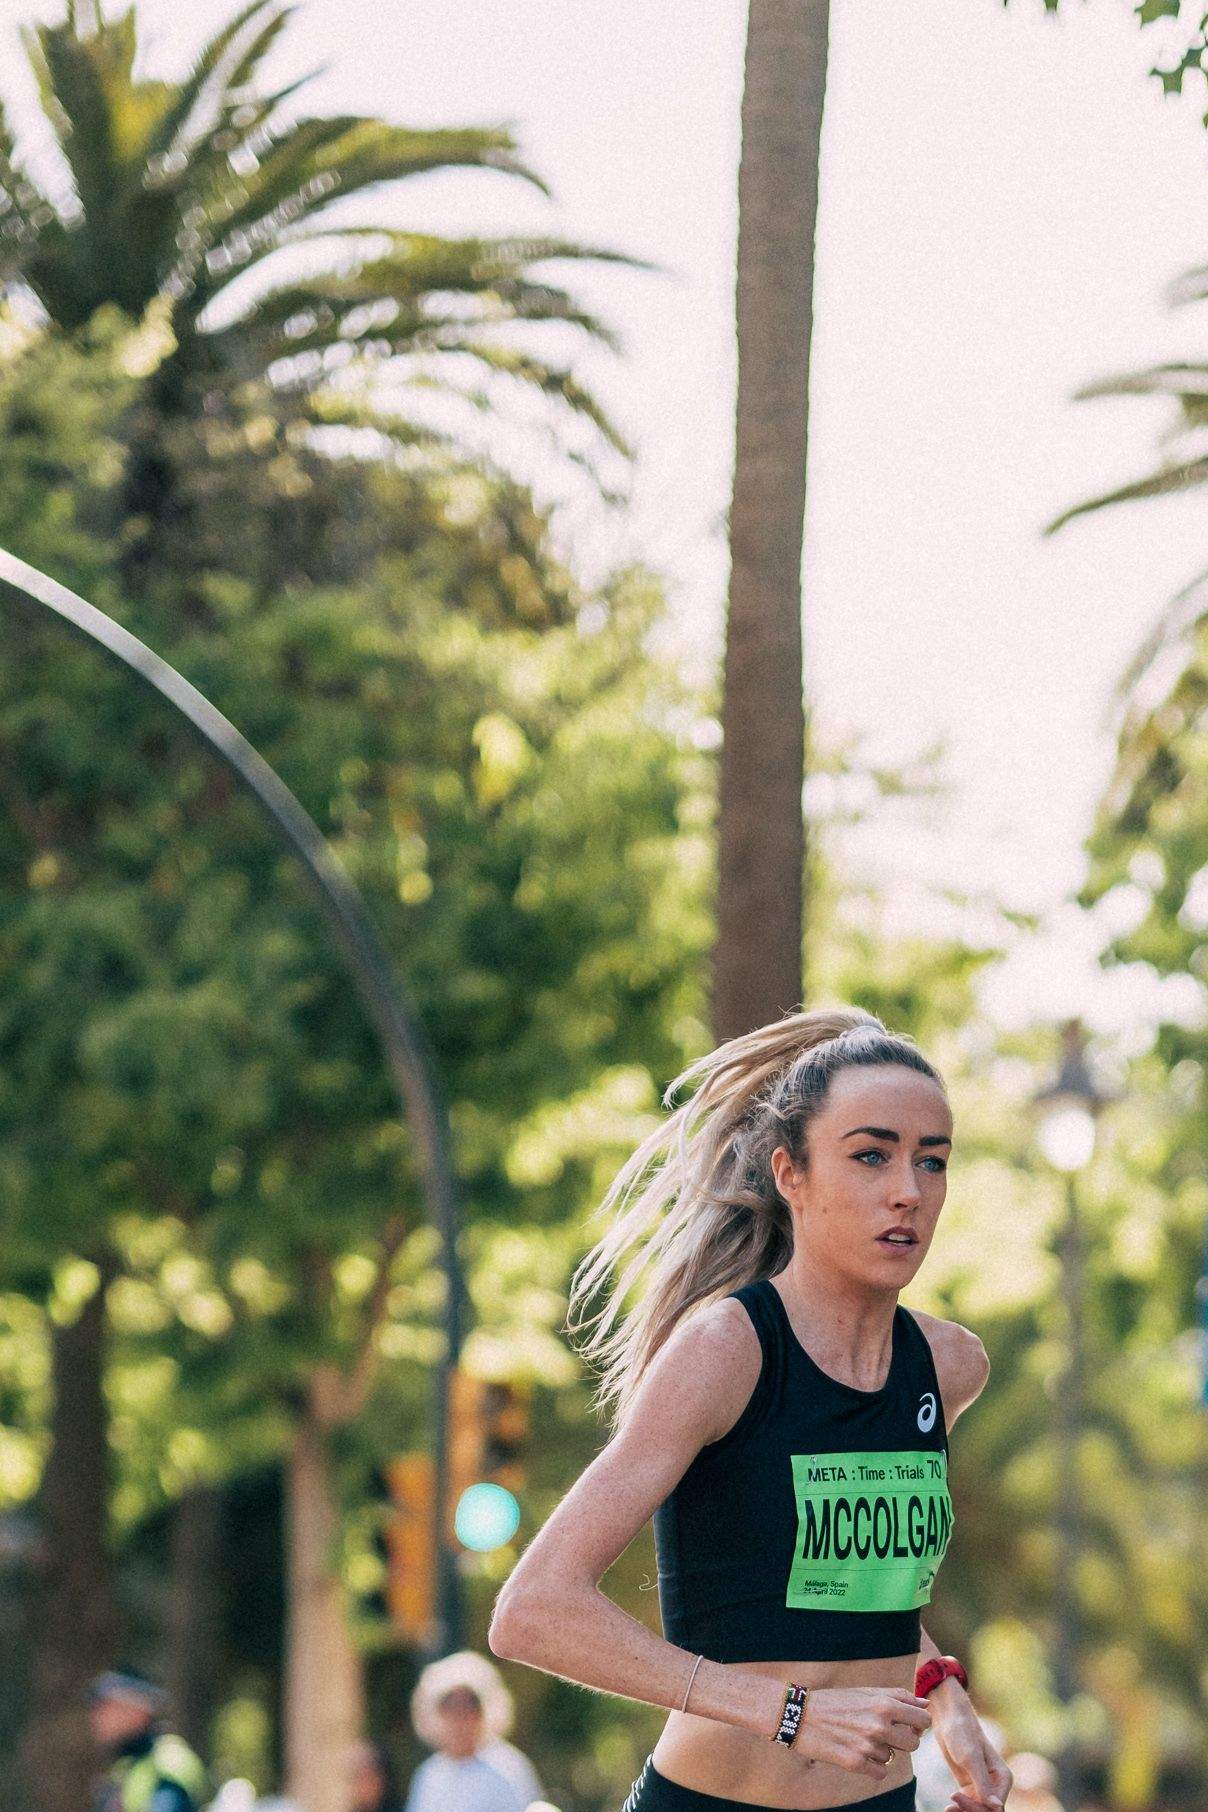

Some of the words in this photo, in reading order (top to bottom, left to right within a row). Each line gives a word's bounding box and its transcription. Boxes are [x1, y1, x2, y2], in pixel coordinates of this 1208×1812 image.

[808, 1467, 847, 1482] META
[858, 1465, 885, 1481] Time
[895, 1465, 925, 1480] Trials
[926, 1459, 942, 1479] 70
[802, 1495, 951, 1561] MCCOLGAN
